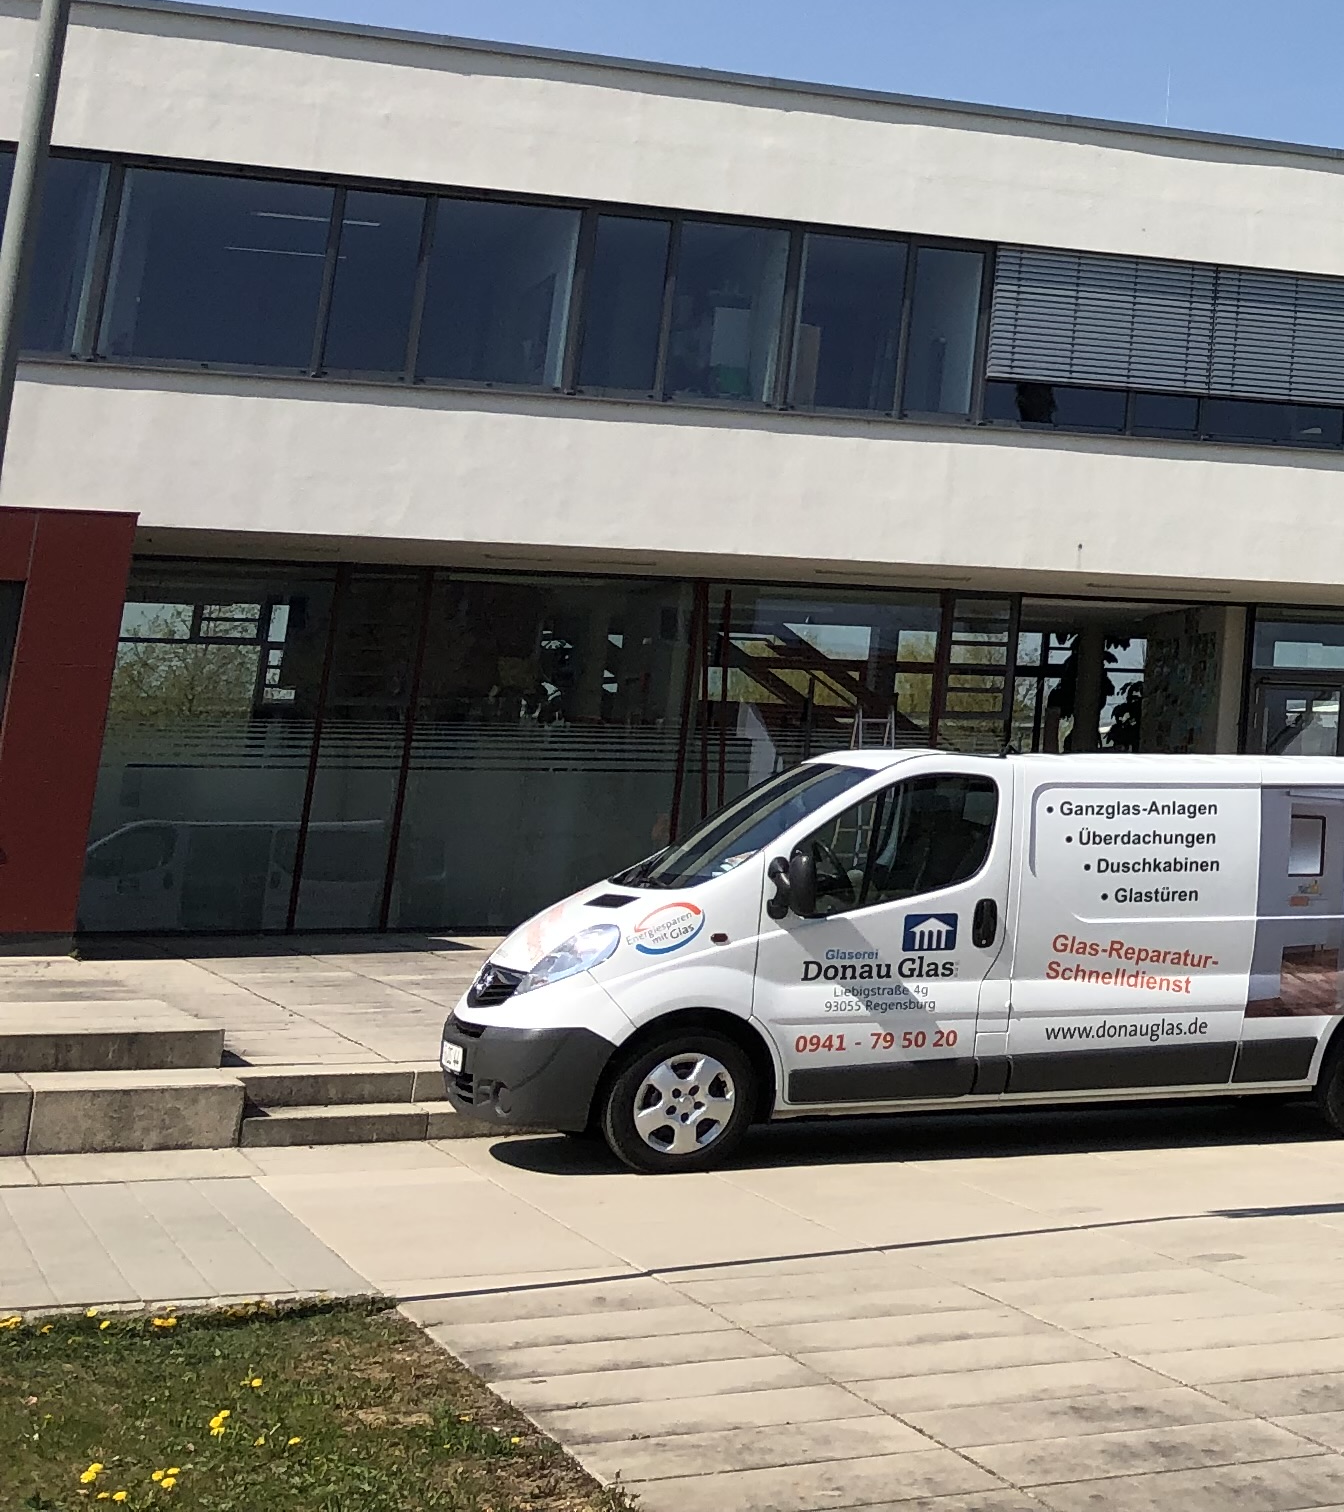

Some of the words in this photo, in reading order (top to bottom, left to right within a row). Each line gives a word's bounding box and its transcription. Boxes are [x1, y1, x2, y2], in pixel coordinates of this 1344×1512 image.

[1060, 801, 1218, 819] Ganzglas-Anlagen
[1078, 828, 1216, 848] Überdachungen
[1096, 857, 1220, 873] Duschkabinen
[1114, 887, 1199, 903] Glastüren
[626, 912, 693, 945] Energiesparen
[652, 933, 668, 944] mit
[670, 924, 695, 939] Glas
[825, 949, 879, 960] Glaserei
[1052, 934, 1219, 969] Glas-Reparatur-
[801, 961, 892, 981] Donau
[898, 956, 955, 979] Glas
[1046, 960, 1192, 994] Schnelldienst
[833, 985, 909, 999] Liebigstraße
[914, 985, 929, 997] 4g
[824, 1001, 861, 1012] 93055
[865, 999, 936, 1013] Regensburg
[1045, 1017, 1208, 1041] www.donauglas.de
[795, 1034, 846, 1053] 0941
[870, 1032, 894, 1050] 79
[902, 1031, 926, 1049] 50
[933, 1030, 958, 1048] 20
